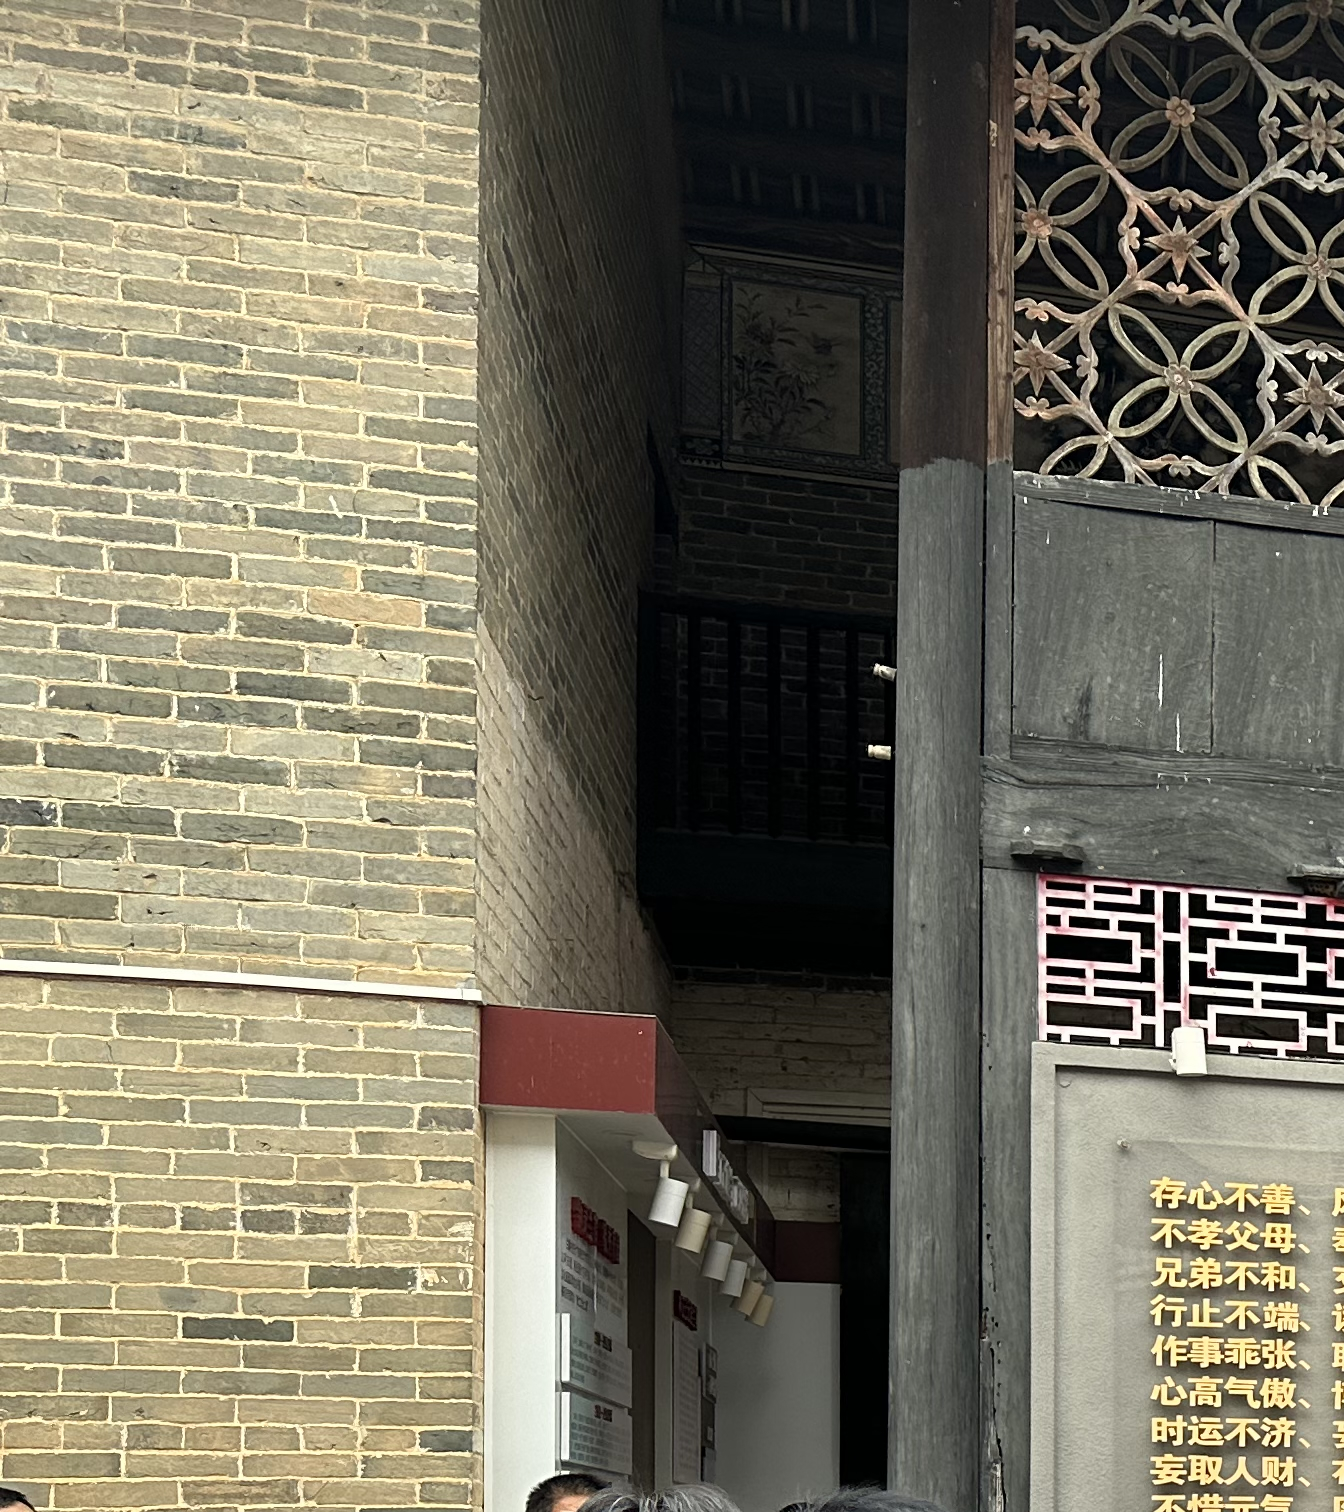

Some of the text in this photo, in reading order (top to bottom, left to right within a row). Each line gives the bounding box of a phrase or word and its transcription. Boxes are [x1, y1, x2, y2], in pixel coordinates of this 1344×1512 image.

[1150, 1176, 1311, 1215] 存心不善、
[1150, 1217, 1311, 1254] 不孝父母、
[1152, 1256, 1311, 1293] 兄弟不和、
[1149, 1294, 1311, 1331] 行止不端、
[1151, 1335, 1311, 1370] 作事乖张、
[1151, 1376, 1311, 1409] 心高气傲、
[1150, 1416, 1311, 1448] 时运不济、
[1150, 1454, 1311, 1487] 妄取人财、
